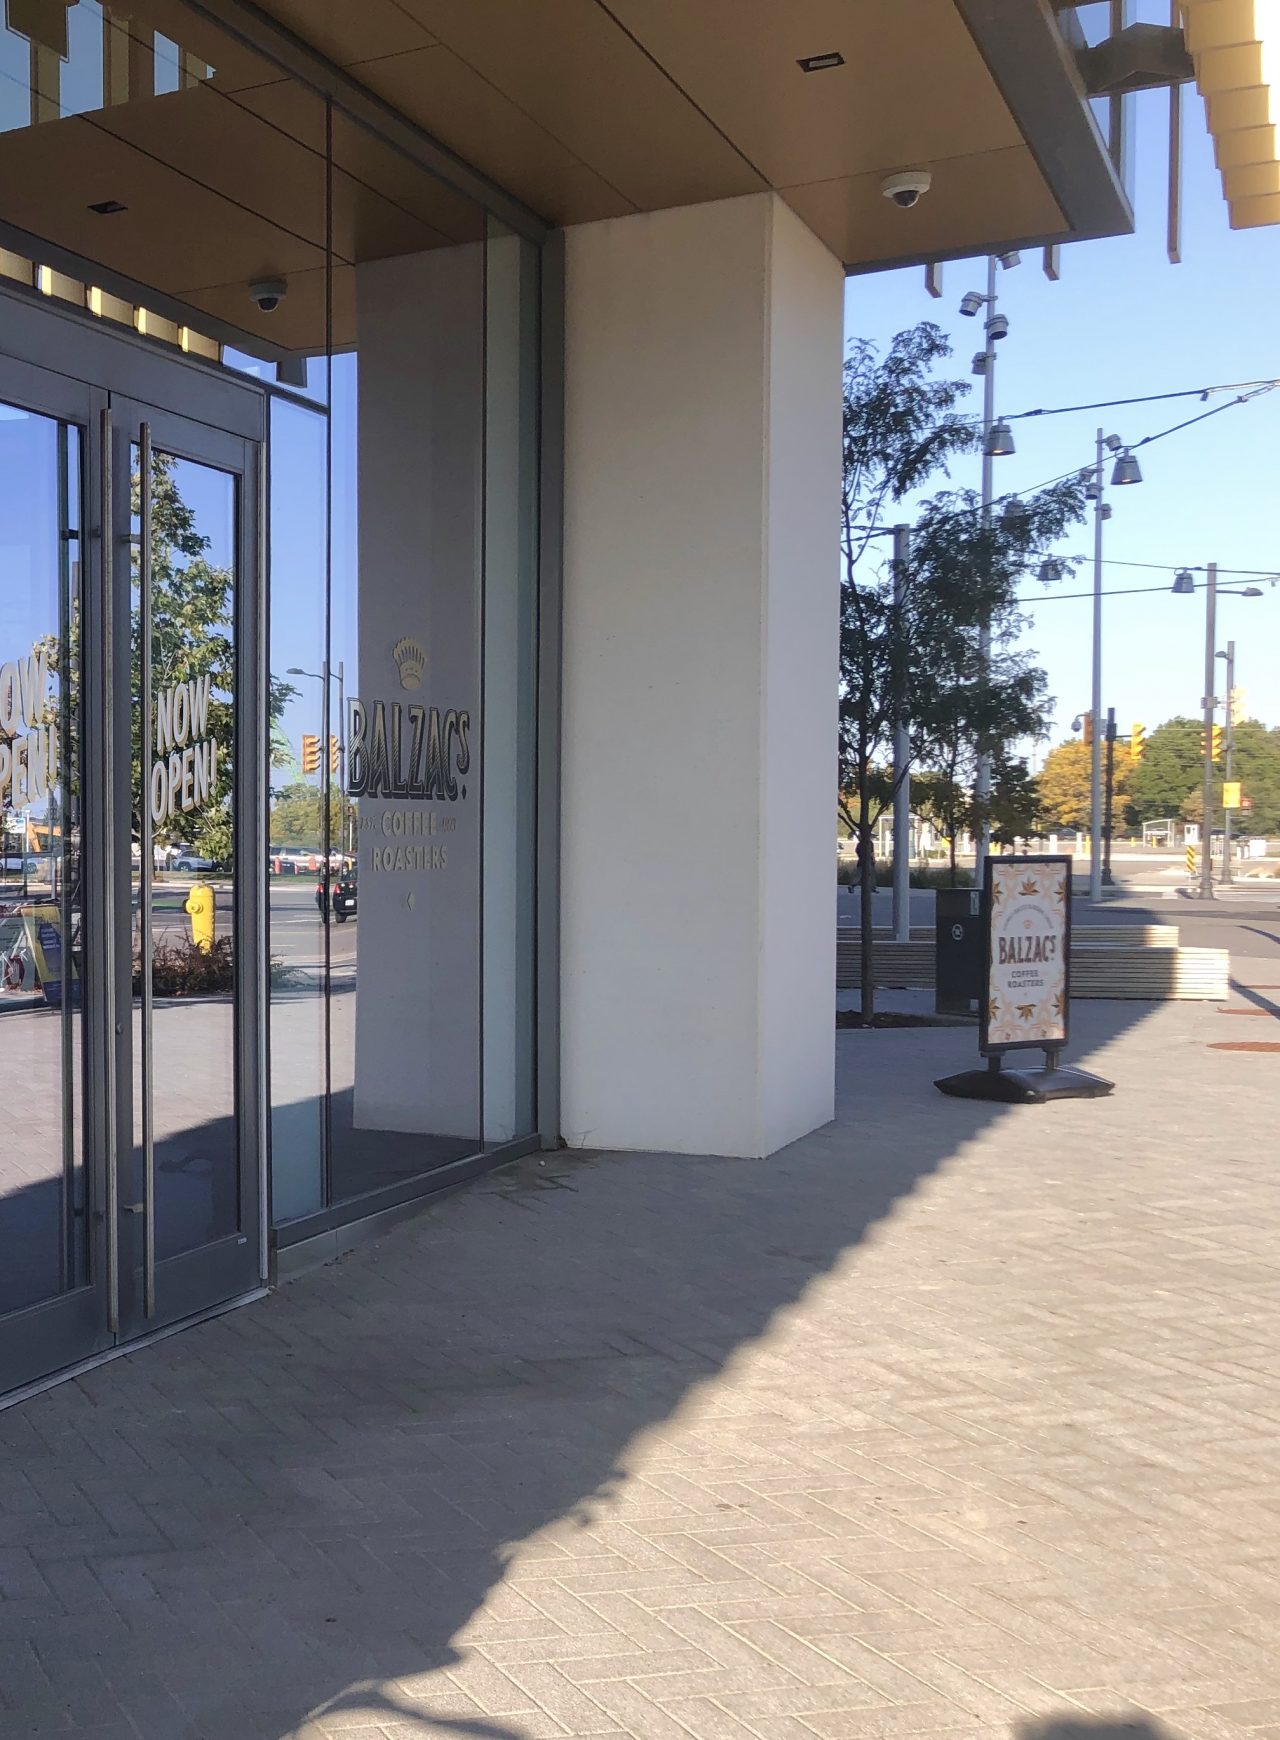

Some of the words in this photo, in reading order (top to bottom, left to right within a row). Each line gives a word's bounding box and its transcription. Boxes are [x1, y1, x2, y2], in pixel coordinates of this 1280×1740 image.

[157, 673, 211, 756] NOW
[151, 737, 218, 826] OPEN!
[380, 809, 438, 838] COFFEE
[372, 845, 449, 873] ROASTERS
[1011, 969, 1039, 979] COFFEE
